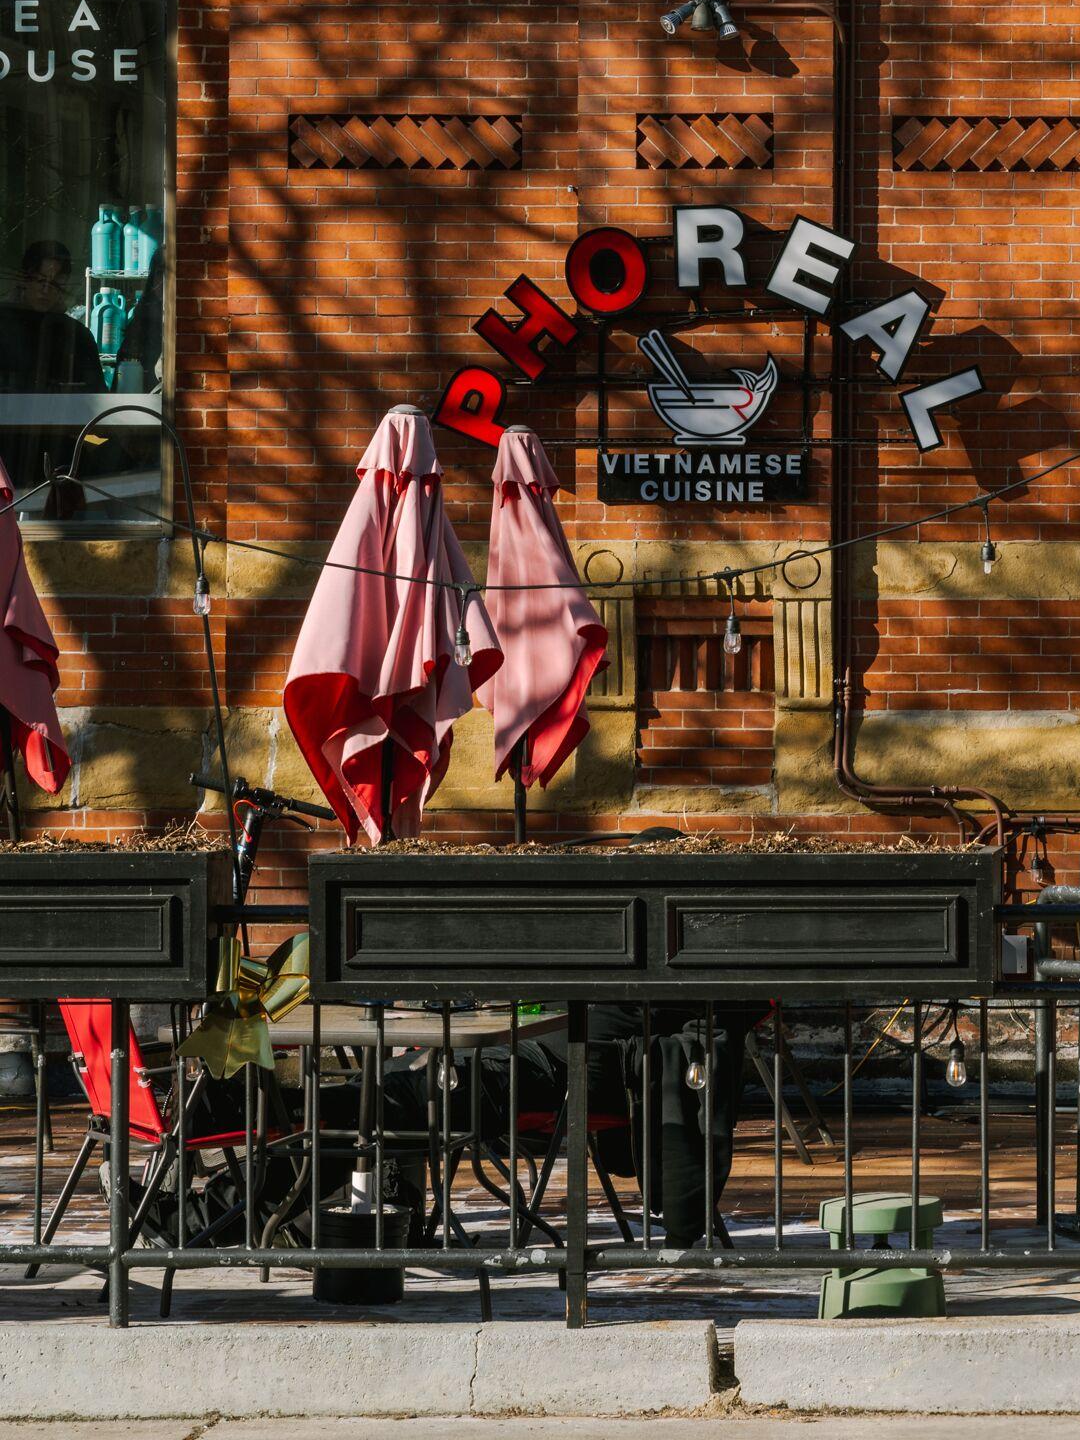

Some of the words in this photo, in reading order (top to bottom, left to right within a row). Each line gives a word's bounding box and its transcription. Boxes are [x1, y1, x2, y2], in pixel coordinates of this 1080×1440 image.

[433, 226, 650, 449] PHO
[673, 204, 988, 454] REAL
[602, 453, 802, 475] VIETNAMESE
[640, 481, 764, 502] CUISINE
